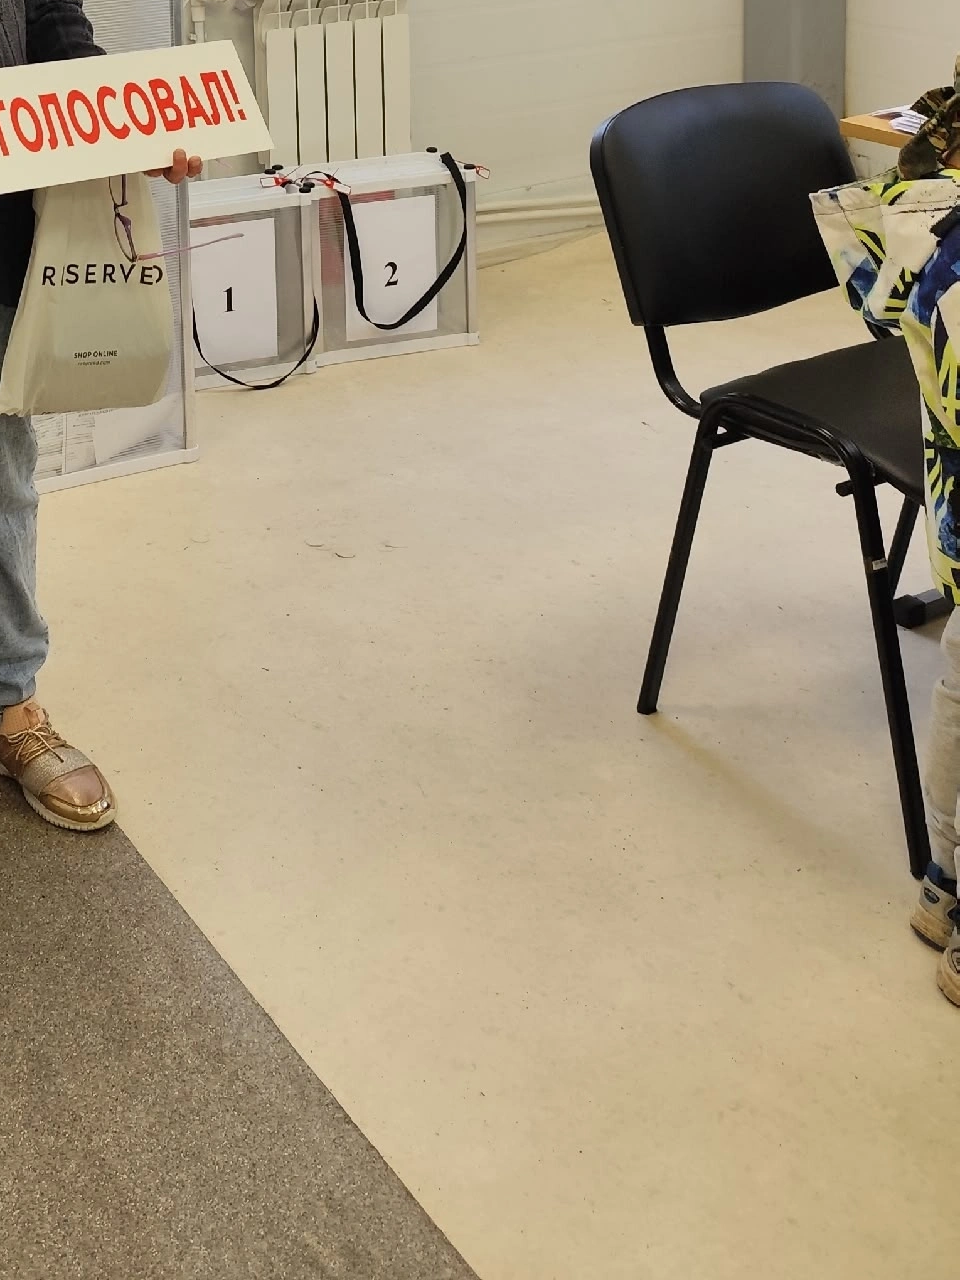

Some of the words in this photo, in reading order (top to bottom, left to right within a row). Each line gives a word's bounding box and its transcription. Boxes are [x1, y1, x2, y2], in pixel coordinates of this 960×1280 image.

[384, 261, 399, 287] 2
[223, 287, 235, 312] 1
[73, 351, 92, 359] SHOP
